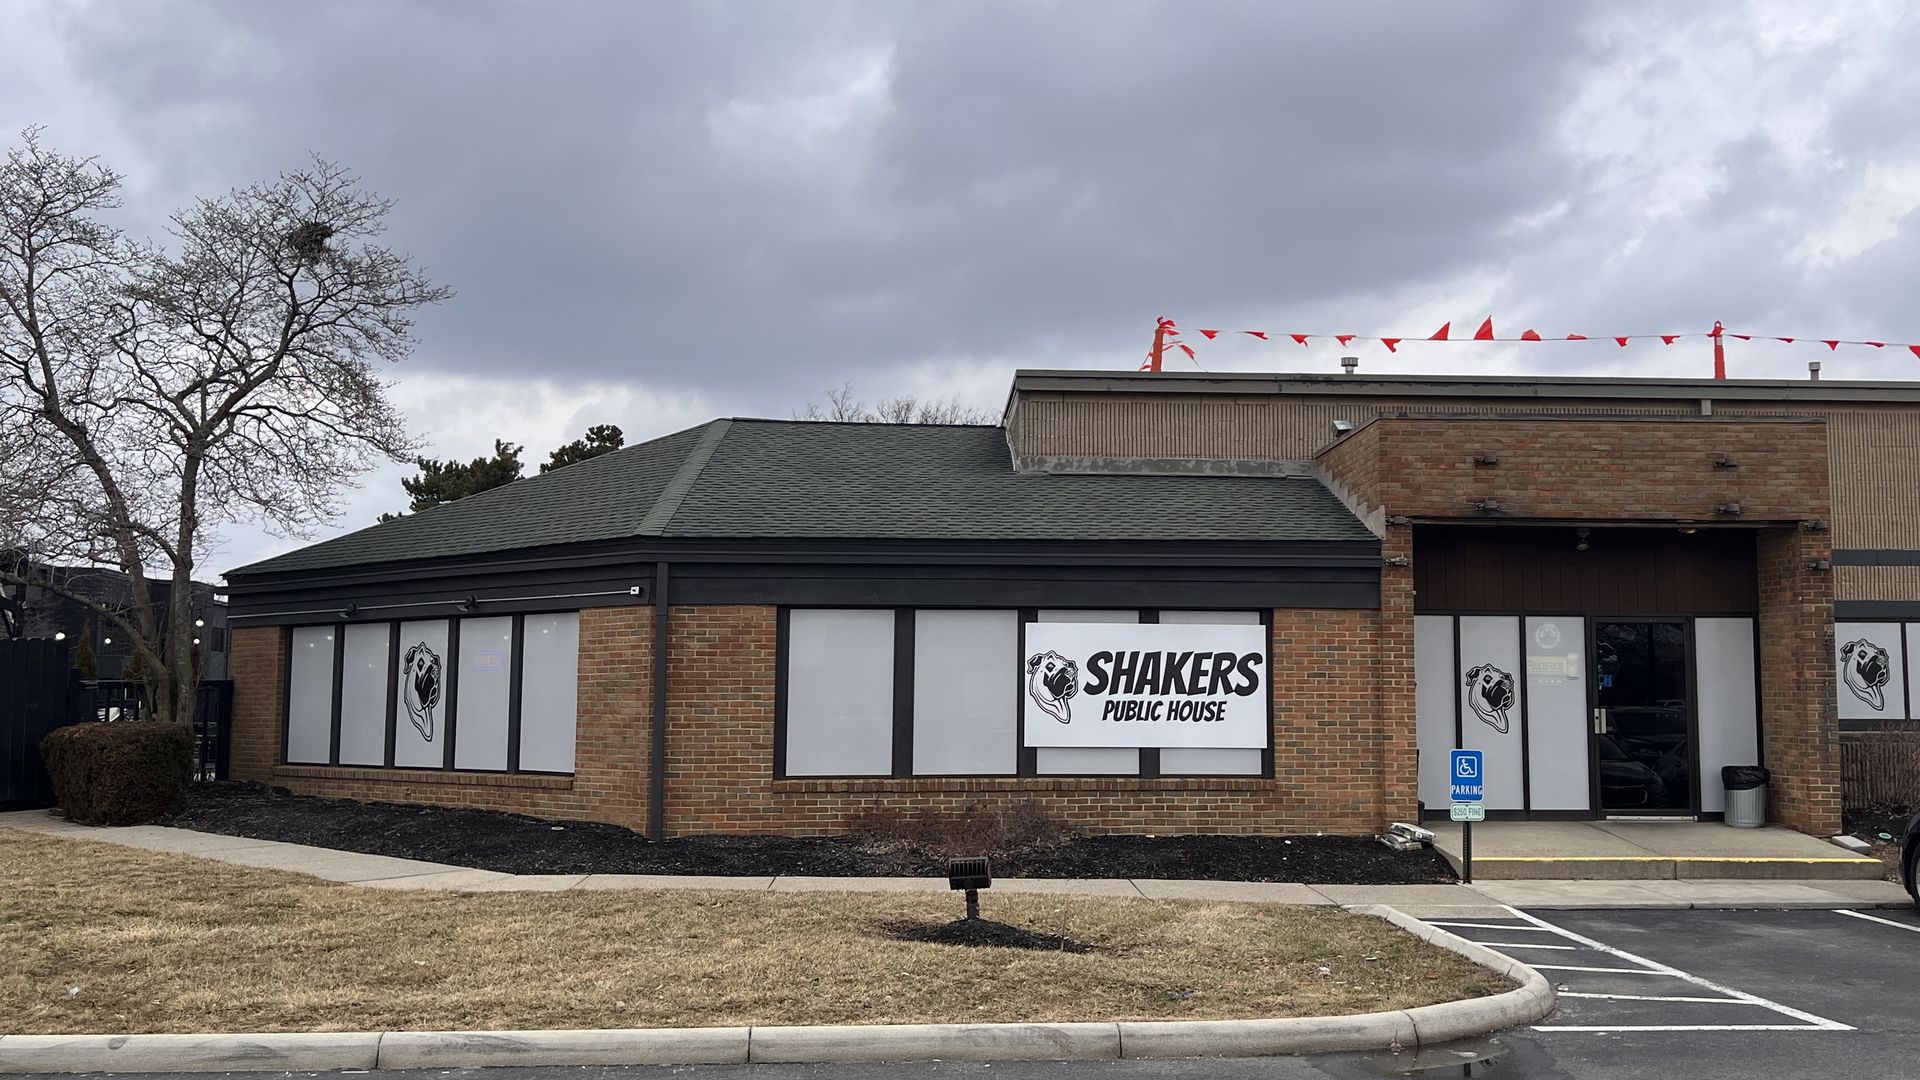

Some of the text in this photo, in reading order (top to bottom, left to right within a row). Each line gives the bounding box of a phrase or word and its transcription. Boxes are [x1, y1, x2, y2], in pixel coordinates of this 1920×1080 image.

[1083, 650, 1263, 697] SHAKERS
[1102, 699, 1227, 723] PUBLIC HOUSE
[1451, 784, 1483, 796] PARKING
[1454, 807, 1481, 816] $250 FINE
